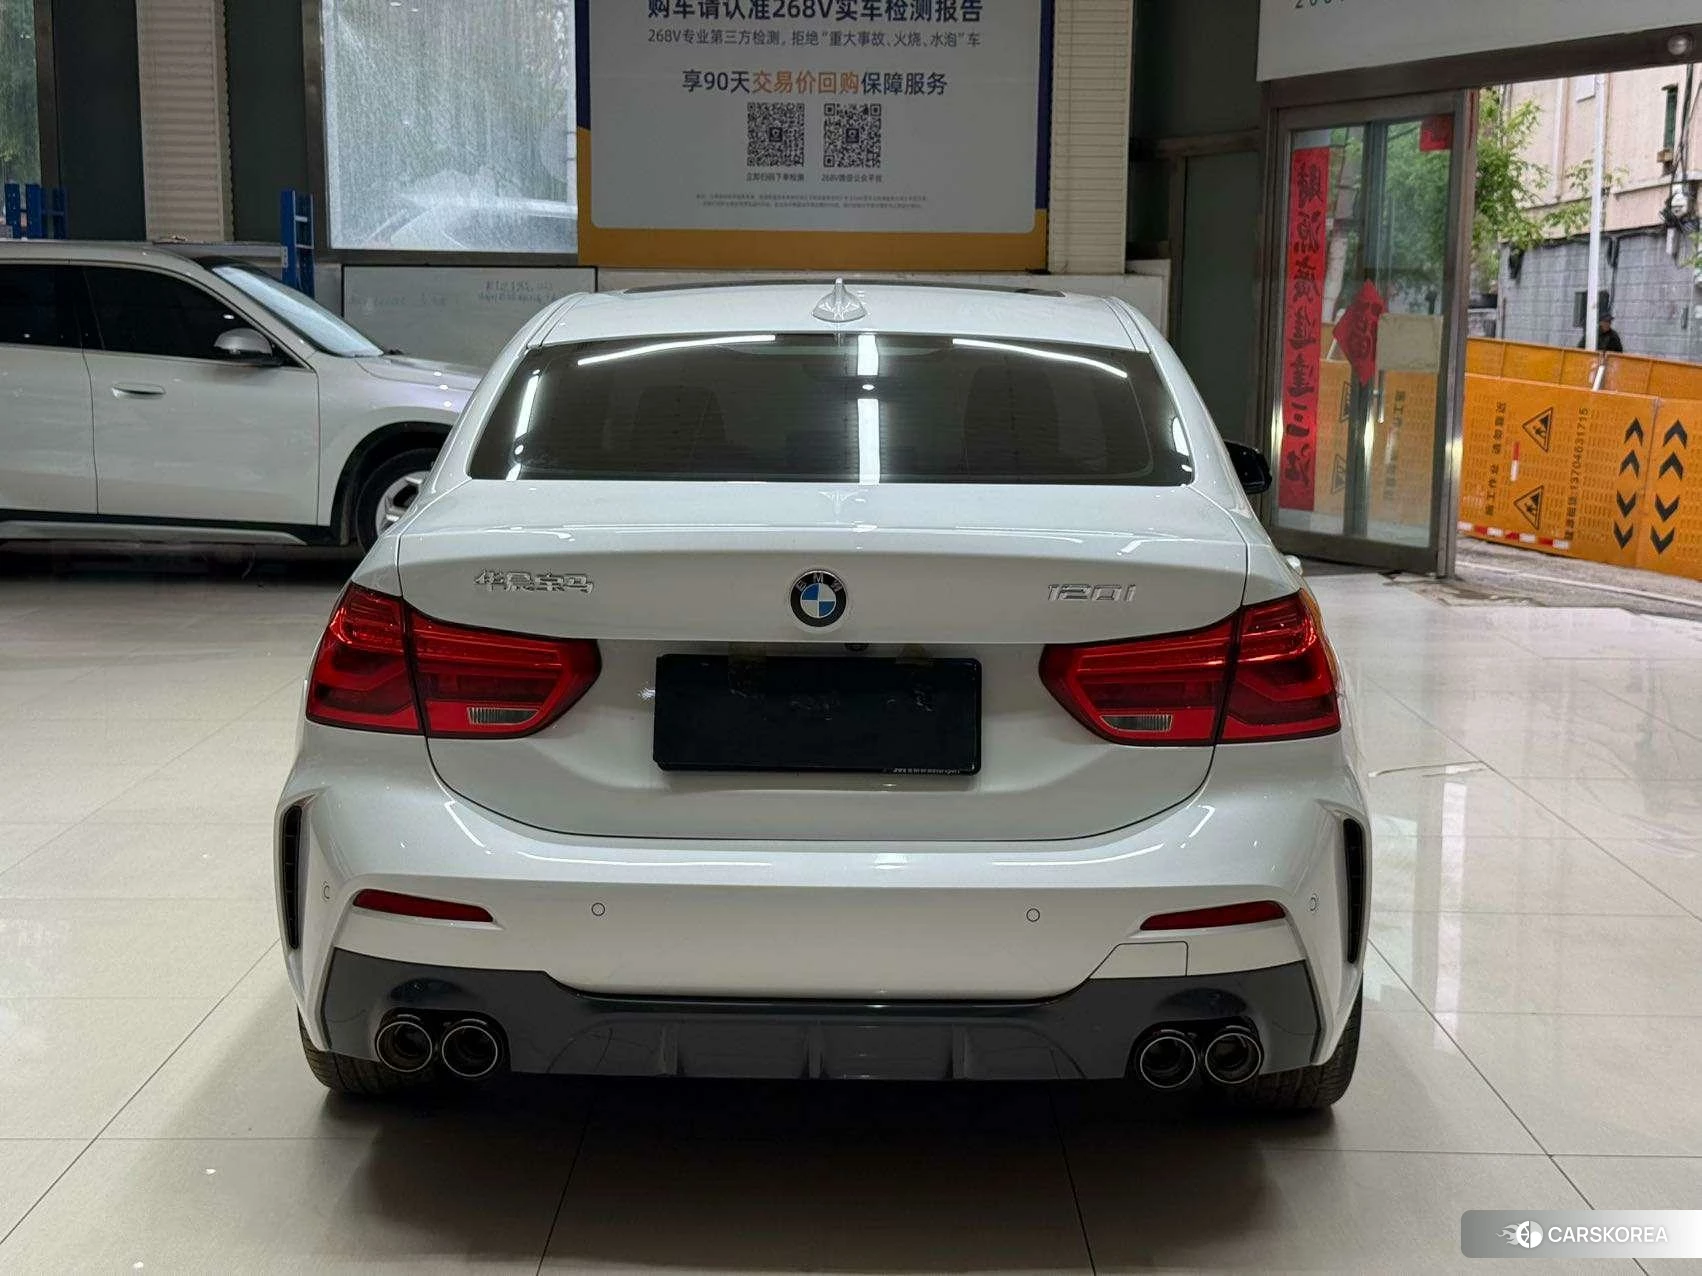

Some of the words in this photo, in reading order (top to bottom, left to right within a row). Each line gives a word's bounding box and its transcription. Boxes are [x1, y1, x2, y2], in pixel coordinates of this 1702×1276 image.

[648, 0, 983, 22] 购车请认准268V实车检测报告
[682, 70, 948, 95] 享90天交易价回购保障服务
[473, 569, 593, 593] 华晨宝马
[1048, 584, 1136, 601] 120i
